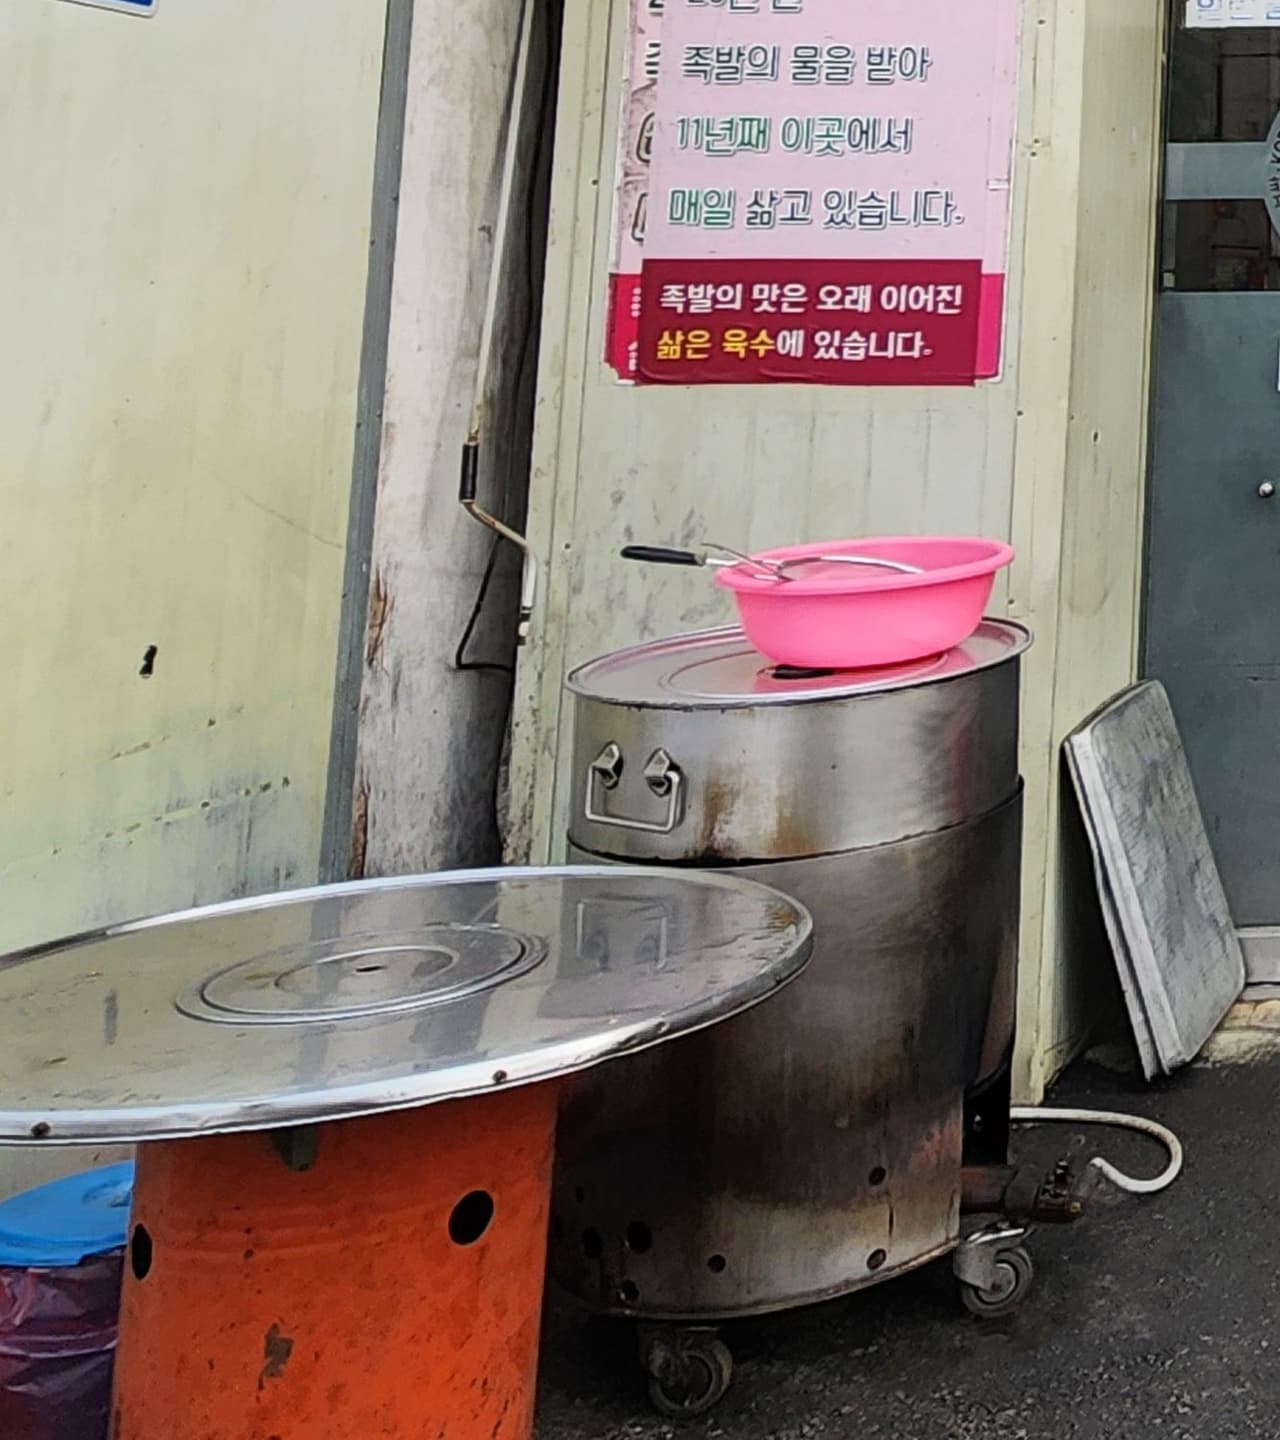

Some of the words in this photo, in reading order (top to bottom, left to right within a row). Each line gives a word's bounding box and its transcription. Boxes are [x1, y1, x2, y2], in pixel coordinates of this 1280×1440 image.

[681, 45, 777, 84] 족발의
[790, 45, 854, 84] 물을
[865, 46, 931, 83] 받아
[676, 116, 769, 157] 11년째
[780, 116, 913, 157] 이곳에서
[668, 189, 735, 228] 매일
[744, 189, 812, 227] 삶고
[823, 190, 965, 227] 있습니다.
[659, 284, 743, 314] 족발의
[751, 283, 809, 314] 맛은
[815, 284, 872, 313] 오래
[880, 284, 963, 314] 이어진
[656, 330, 712, 361] 삶은
[721, 329, 805, 360] 육수에
[813, 330, 934, 360] 있습니다.
